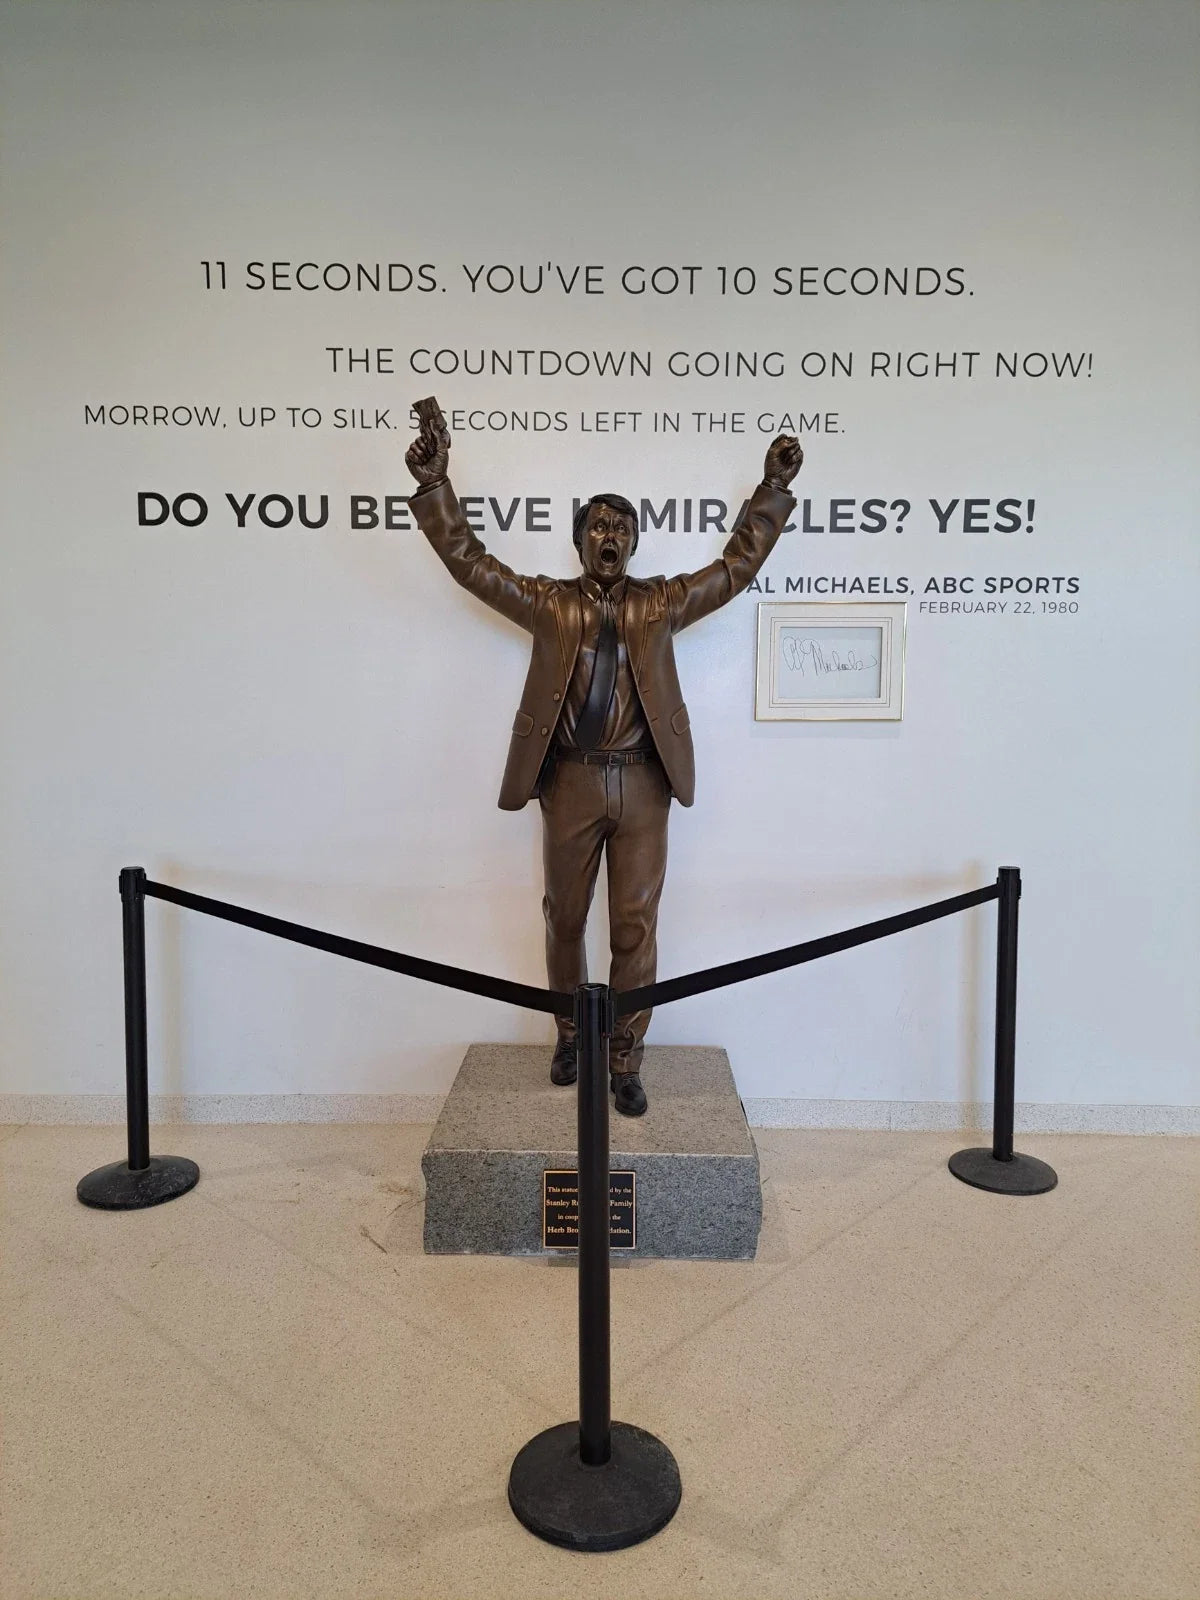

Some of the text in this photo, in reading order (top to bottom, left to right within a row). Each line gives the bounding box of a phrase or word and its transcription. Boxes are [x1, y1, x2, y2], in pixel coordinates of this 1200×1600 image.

[201, 260, 974, 297] 11 SECONDS. YOU'VE GOT 10 SECONDS.
[326, 347, 1093, 378] THE COUNTDOWN GOING ON RIGHT NOW!
[85, 404, 227, 430] MORROW,
[239, 406, 277, 429] UP
[286, 407, 322, 429] TO
[334, 408, 398, 430] SILK.
[440, 410, 568, 432] ECONDS
[582, 411, 643, 433] LEFT
[655, 412, 680, 433] IN
[692, 412, 746, 433] THE
[758, 412, 845, 434] GAME.
[138, 492, 209, 528] DO
[225, 493, 329, 530] YOU
[350, 495, 552, 532] BEEVE
[640, 498, 911, 534] MIRLES?
[929, 498, 1036, 535] YES!
[786, 576, 915, 597] MICHAELS,
[924, 576, 975, 594] ABC
[984, 576, 1080, 594] SPORTS
[919, 601, 1079, 615] FEBRUARY 22, 1980
[545, 1199, 570, 1208] Stanley
[610, 1199, 633, 1209] Family
[547, 1226, 565, 1234] Herb
